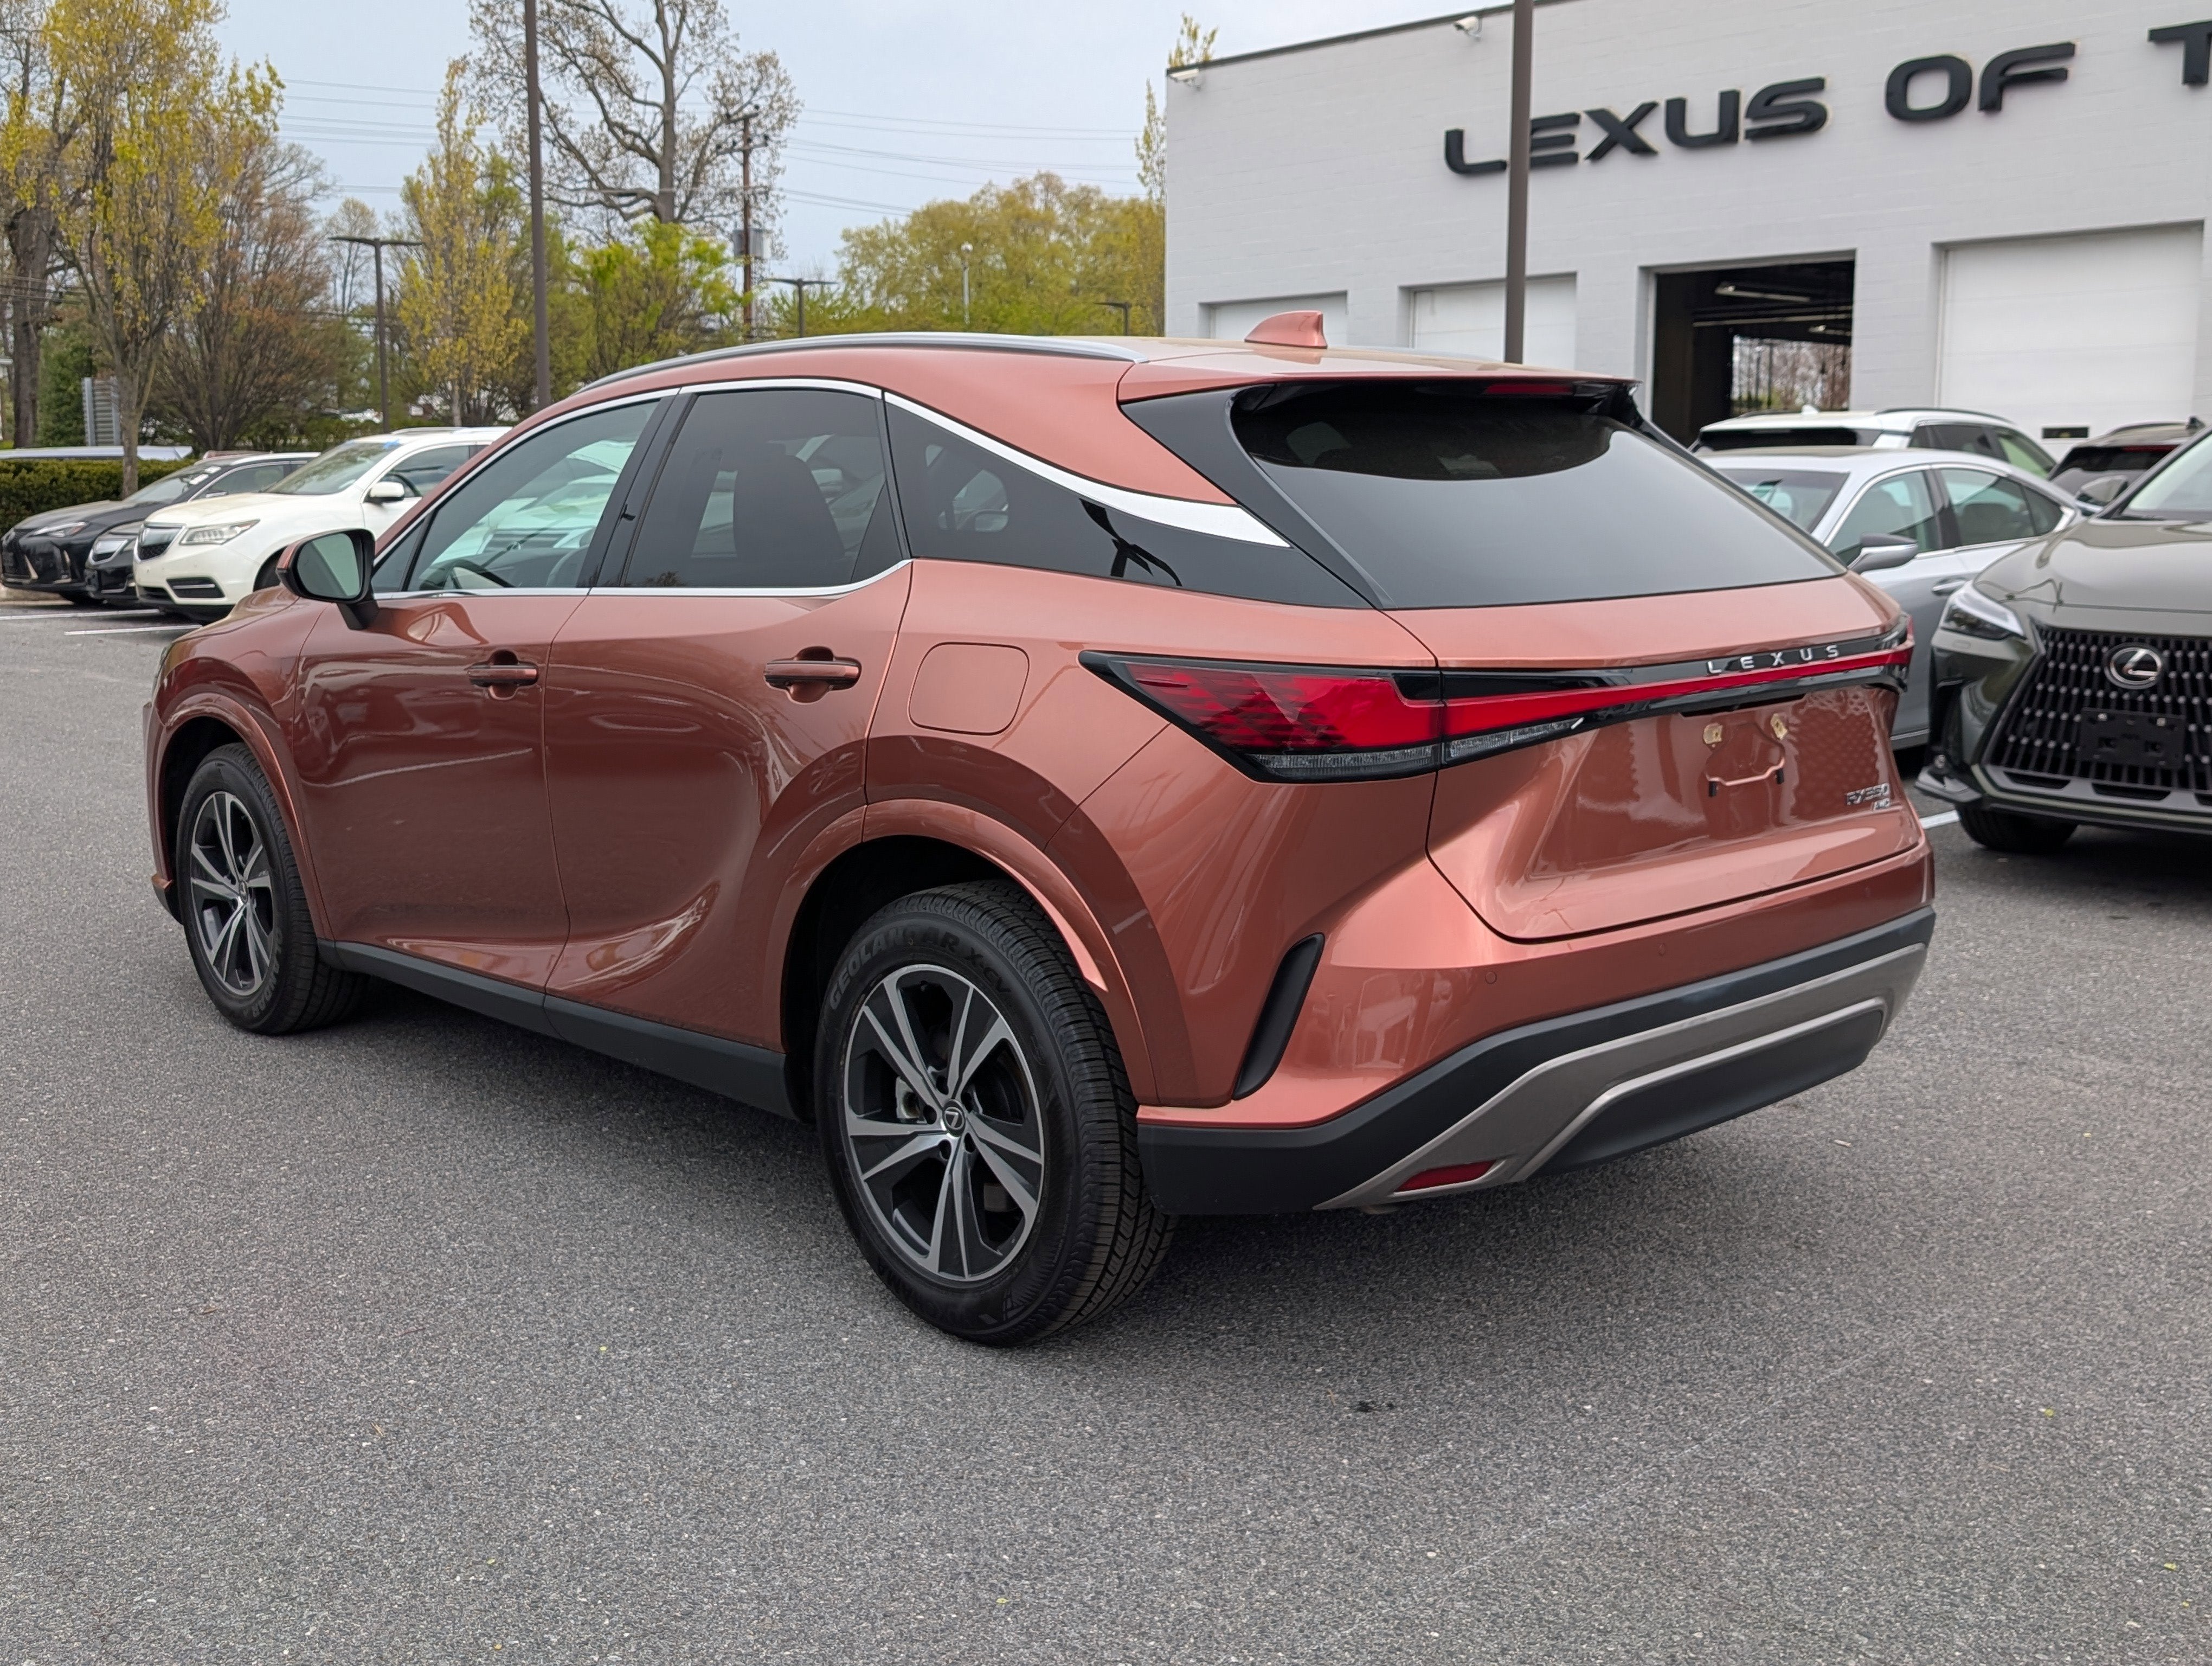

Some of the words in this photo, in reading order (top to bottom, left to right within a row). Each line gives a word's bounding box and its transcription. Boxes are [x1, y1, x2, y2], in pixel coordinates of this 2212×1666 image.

[1444, 76, 1829, 175] LEXUS
[1885, 42, 2075, 122] OF
[2147, 21, 2212, 85] T
[1706, 644, 1840, 674] LEXUS
